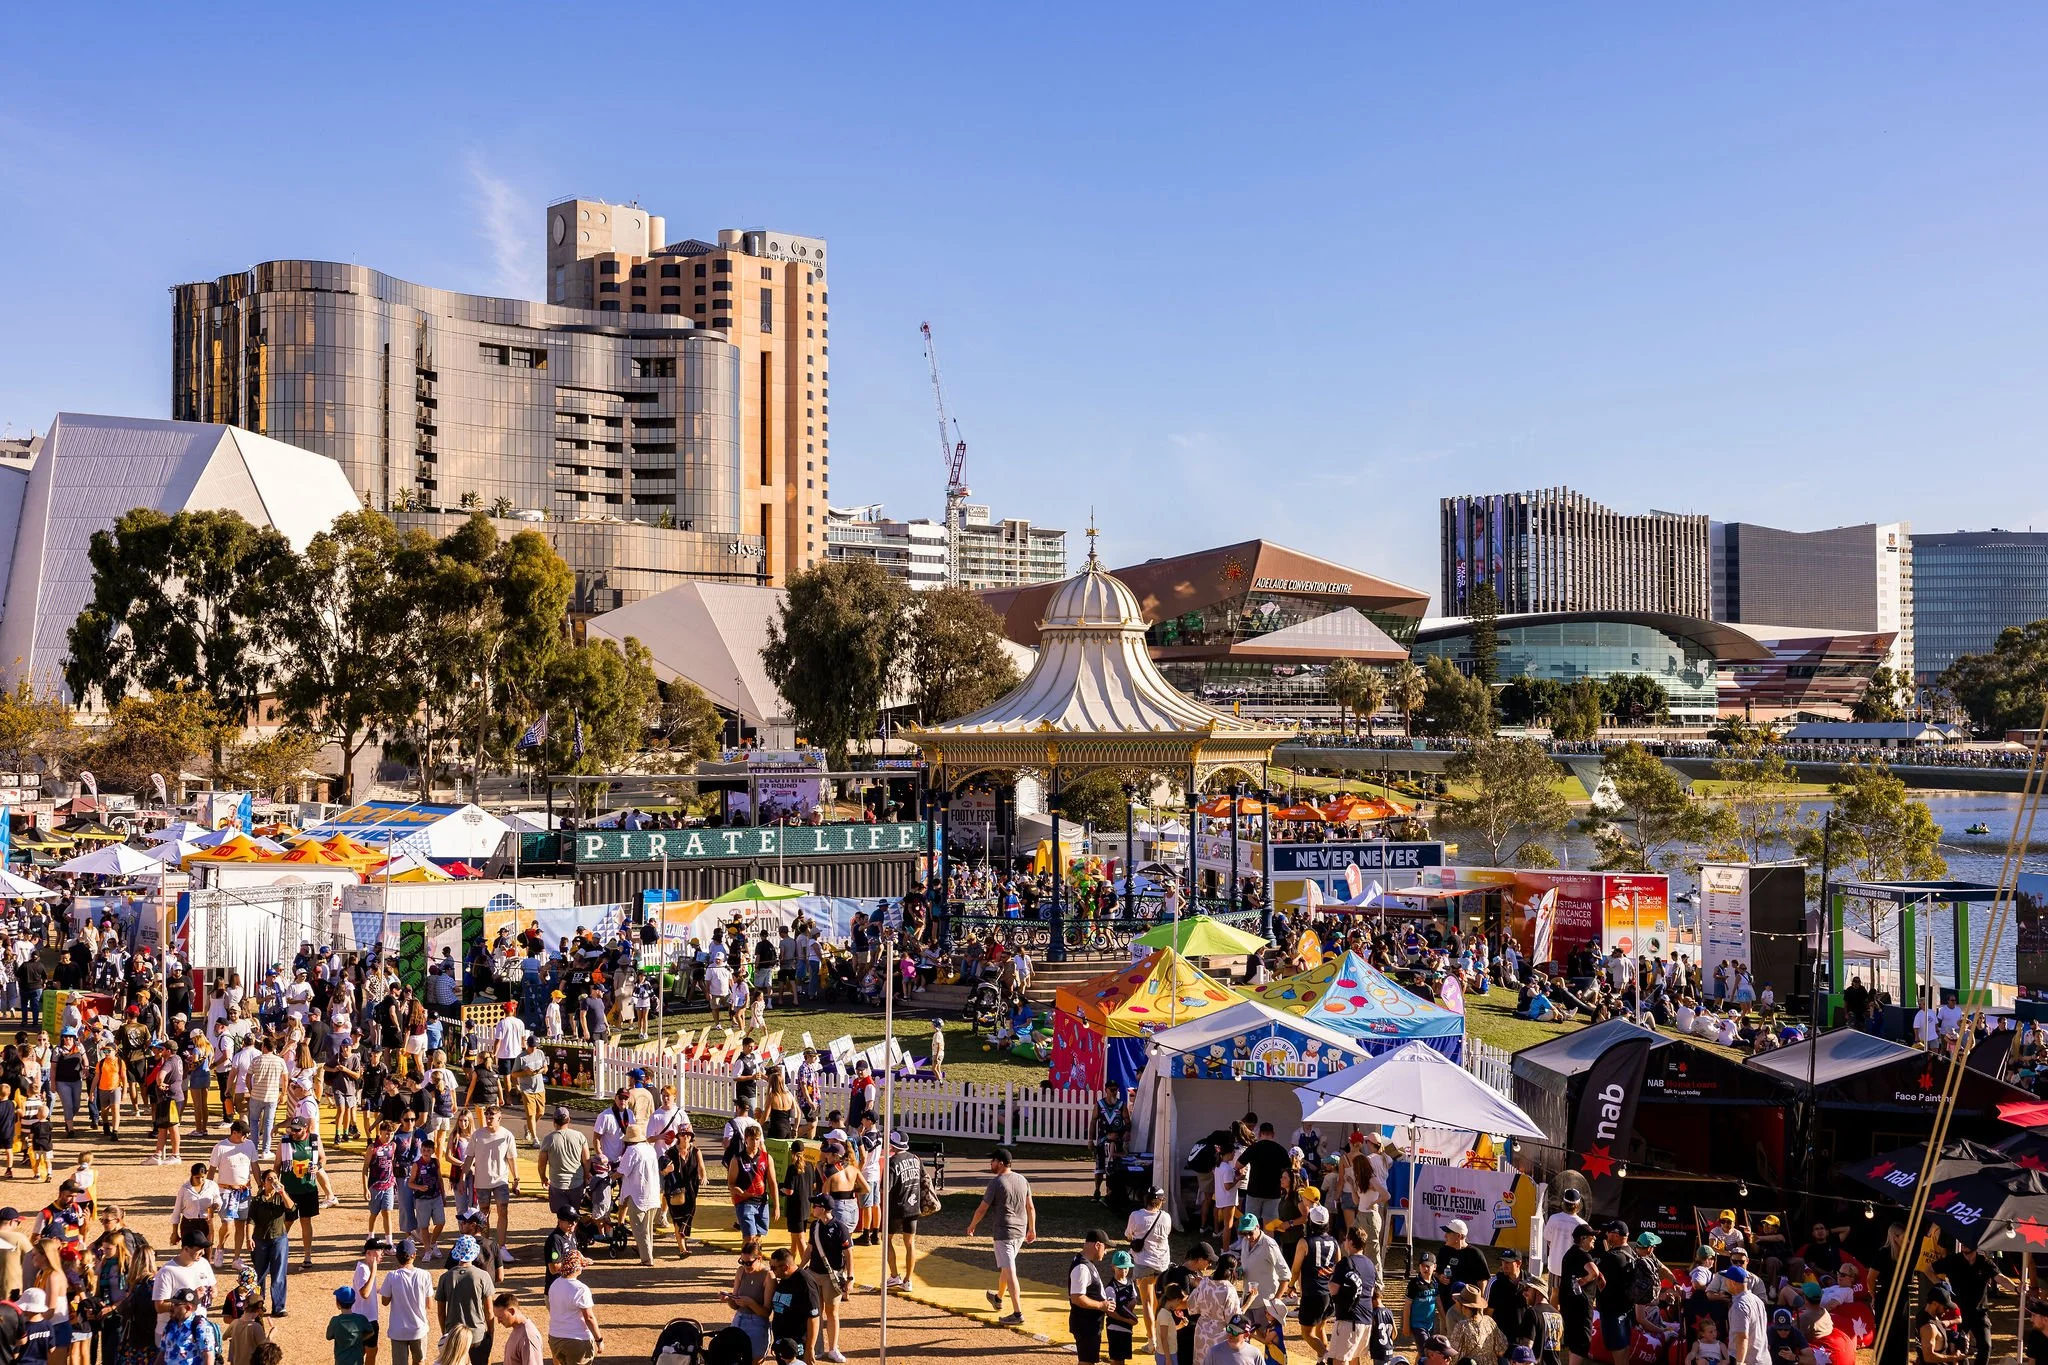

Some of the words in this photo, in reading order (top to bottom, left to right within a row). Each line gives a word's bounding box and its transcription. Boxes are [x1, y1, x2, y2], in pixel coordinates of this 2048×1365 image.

[1255, 578, 1288, 590] ADELAIDE
[1288, 580, 1328, 592] CONVENTION
[1328, 583, 1353, 594] CENTRE
[951, 808, 975, 822] FOOTY
[584, 830, 776, 859] PIRATE
[814, 825, 915, 852] LIFE
[1295, 850, 1355, 869] NEVER
[1359, 848, 1420, 868] NEVER
[1847, 887, 1859, 895] GOAL
[1860, 888, 1877, 898] SQUARE
[1878, 890, 1891, 900] STAGE
[1556, 901, 1592, 909] USTRALIAN
[1566, 909, 1592, 919] CANCER
[1555, 917, 1592, 928] OUNDATION
[1232, 1060, 1317, 1078] WORKSHOP
[1647, 1079, 1665, 1087] NAB
[1895, 1091, 1917, 1101] Face
[1597, 1083, 1625, 1140] nab
[296, 1164, 305, 1175] T
[900, 1168, 920, 1184] BLUES
[1883, 1169, 1918, 1188] nab
[1422, 1191, 1449, 1207] FOOTY
[1450, 1195, 1487, 1212] FESTIVAL
[1430, 1205, 1455, 1213] GATHER
[1456, 1208, 1480, 1216] ROUND
[1946, 1201, 1983, 1226] nab
[1640, 1221, 1657, 1229] NAB
[1315, 1240, 1335, 1267] 17
[1638, 1350, 1657, 1363] nab
